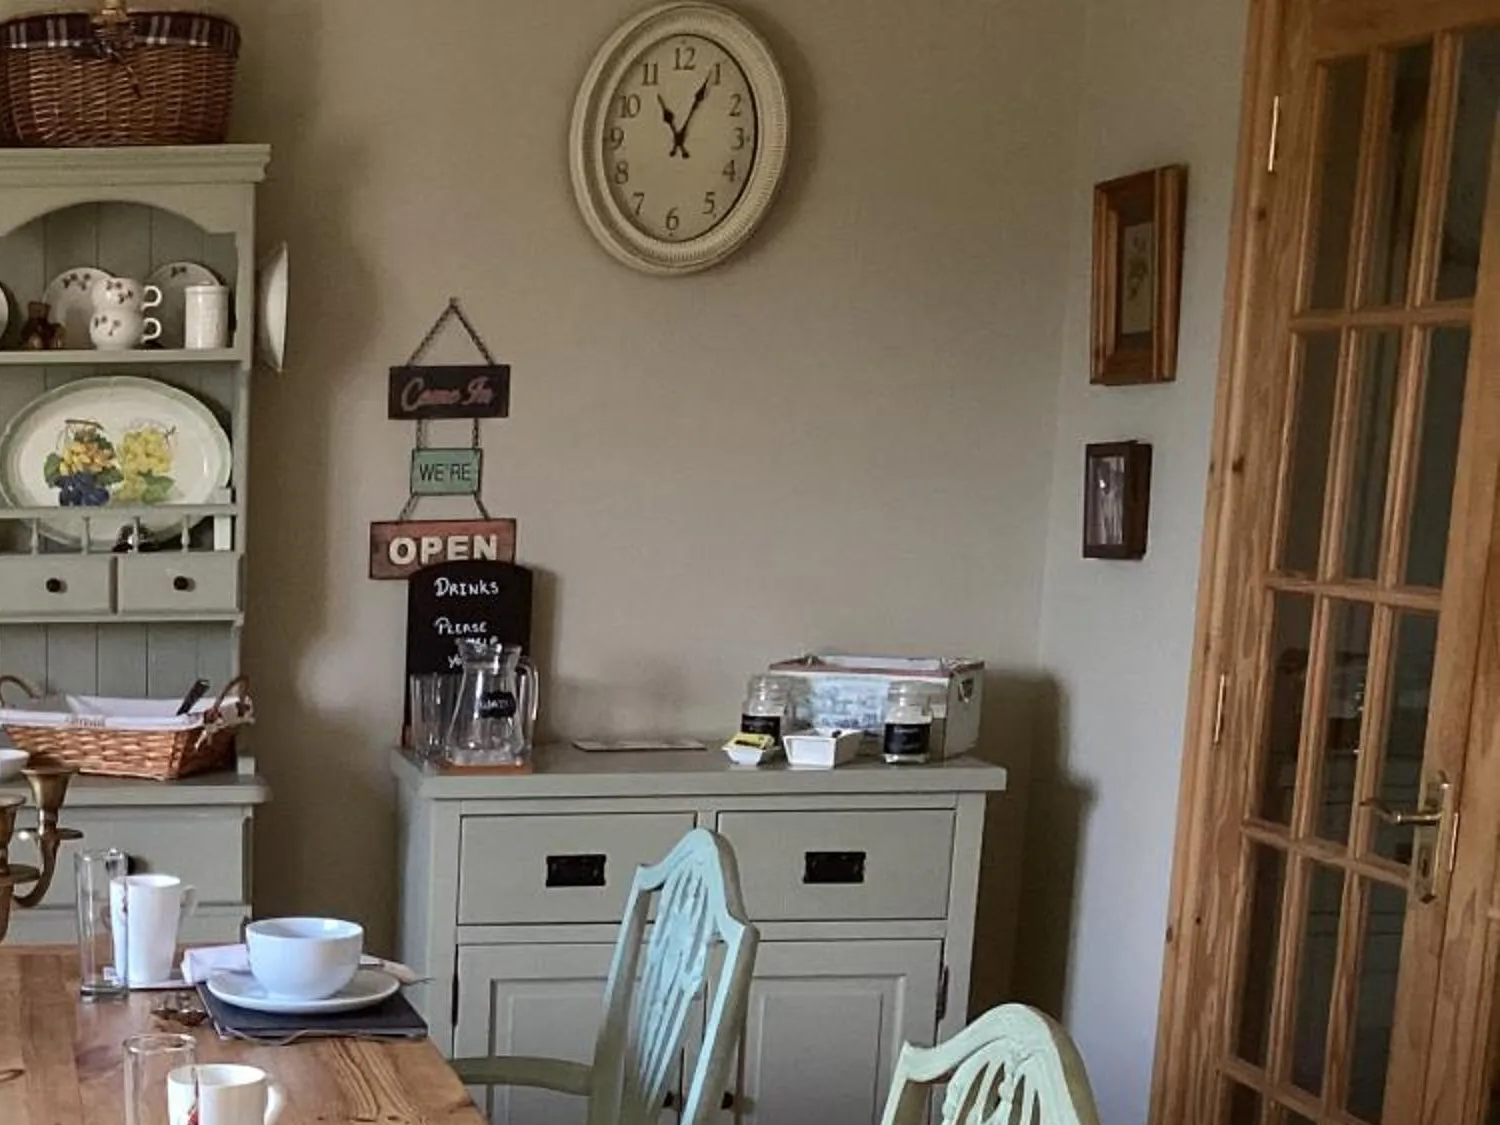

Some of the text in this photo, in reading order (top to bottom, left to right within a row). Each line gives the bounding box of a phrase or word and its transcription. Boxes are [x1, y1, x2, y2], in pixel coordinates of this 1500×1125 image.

[673, 47, 696, 71] 12
[641, 63, 659, 86] 11
[713, 63, 722, 85] 1
[619, 94, 641, 119] 10
[729, 94, 742, 117] 2
[610, 127, 624, 151] 9
[731, 127, 745, 151] 3
[616, 160, 629, 185] 8
[722, 159, 736, 182] 4
[633, 192, 645, 216] 7
[703, 192, 716, 215] 5
[666, 207, 680, 231] 6
[419, 462, 472, 482] WE'RE
[389, 534, 498, 565] OPEN
[434, 577, 499, 597] DRINKS
